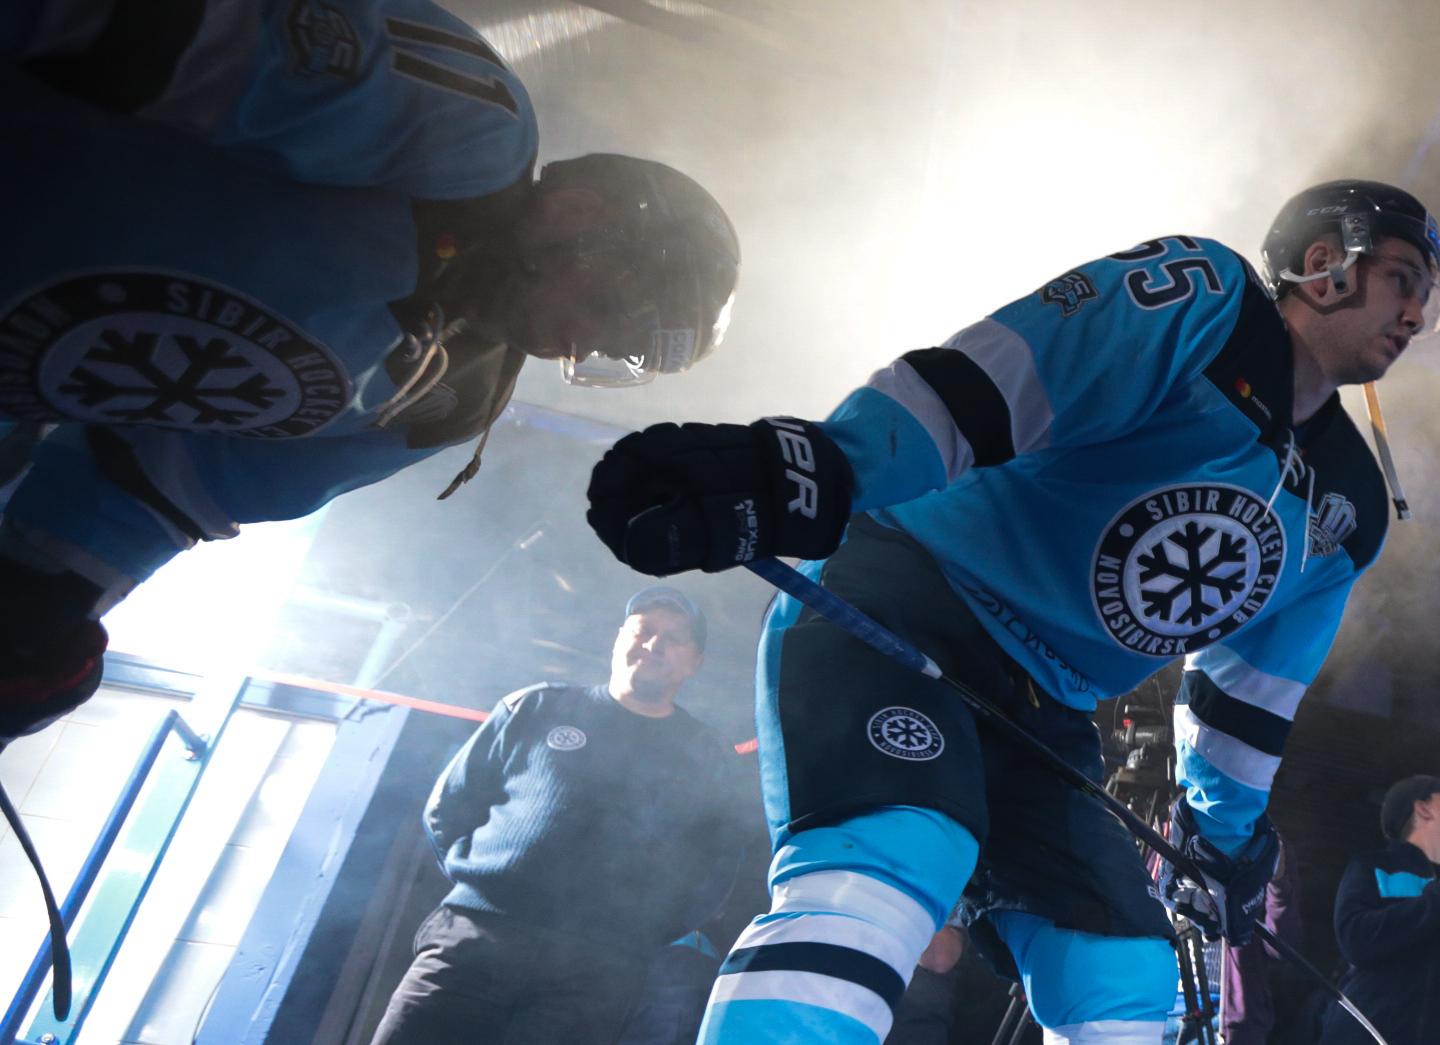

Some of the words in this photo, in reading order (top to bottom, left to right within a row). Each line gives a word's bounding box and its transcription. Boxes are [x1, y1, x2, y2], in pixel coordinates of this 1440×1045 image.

[385, 16, 520, 119] 11
[166, 282, 293, 351] SIBIR
[744, 498, 759, 563] NEXUS
[1145, 489, 1221, 521] SIBIR
[1229, 494, 1282, 562] HOCKEY
[1097, 553, 1190, 654] NOVOSIBIRSK
[1231, 573, 1276, 624] CLUB
